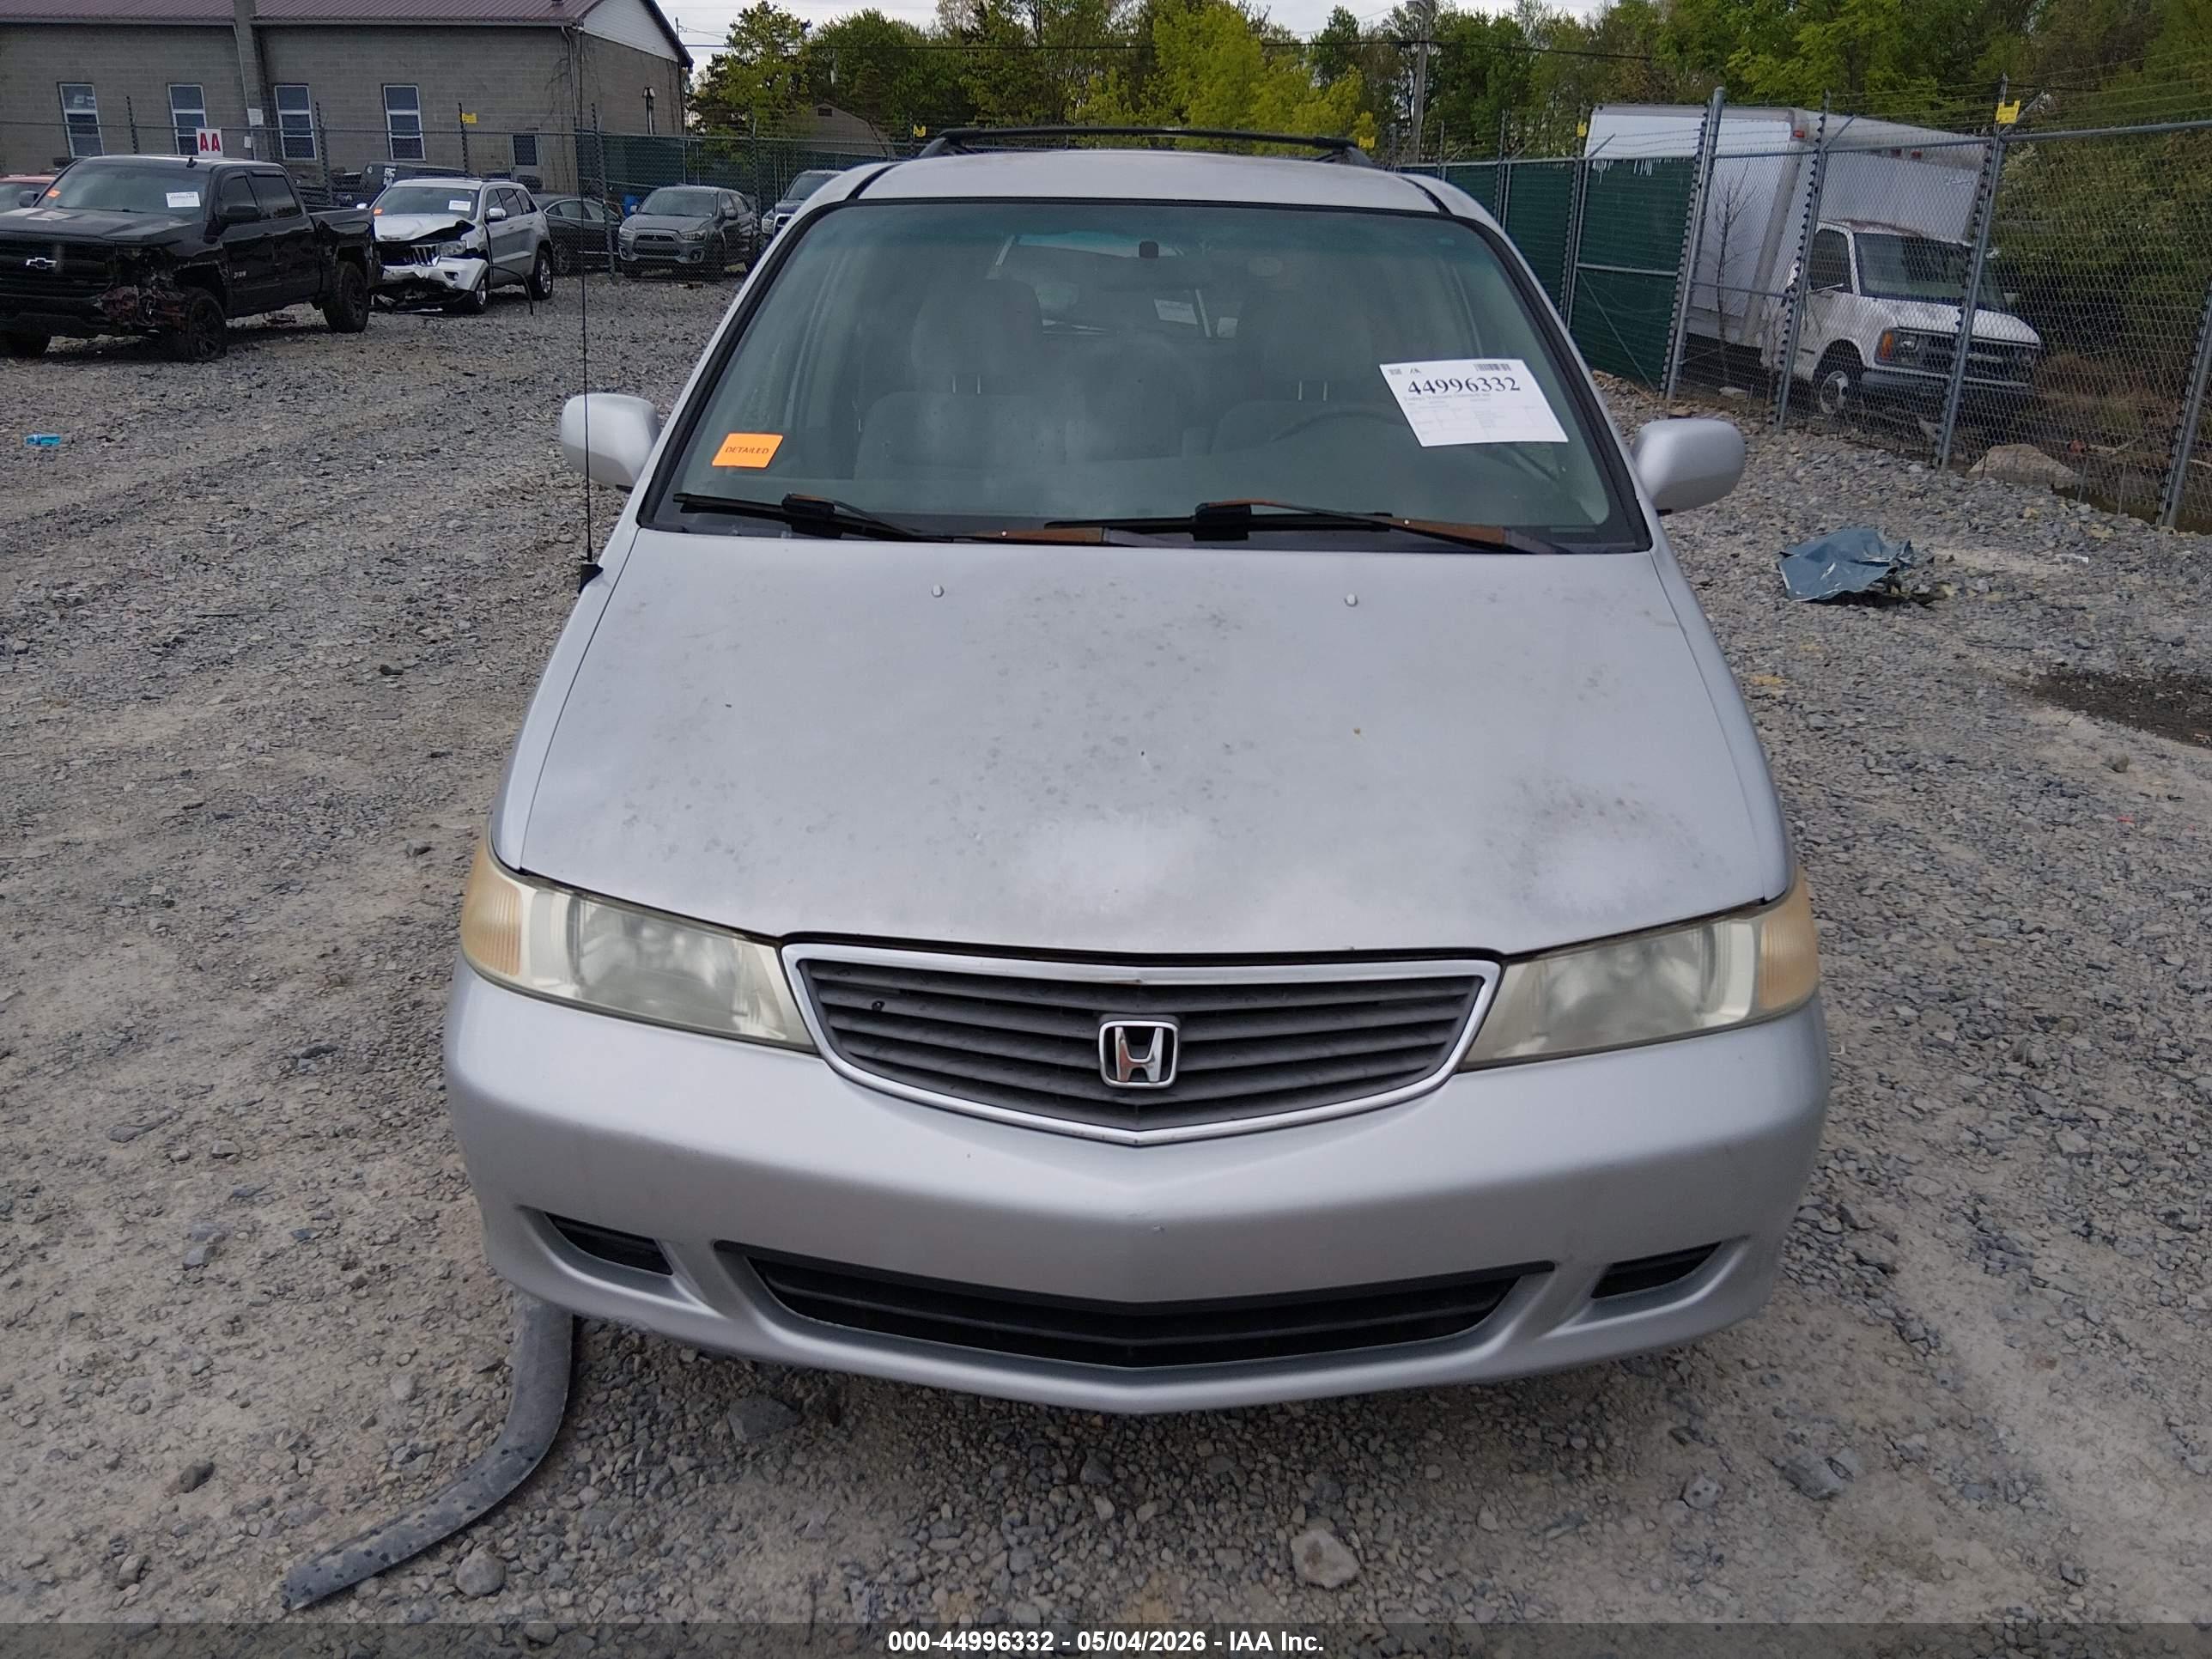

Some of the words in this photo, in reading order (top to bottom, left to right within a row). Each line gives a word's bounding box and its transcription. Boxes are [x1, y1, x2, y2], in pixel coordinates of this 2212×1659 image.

[199, 132, 222, 152] AA
[1408, 376, 1521, 395] 44996332
[725, 446, 769, 454] DETAILED
